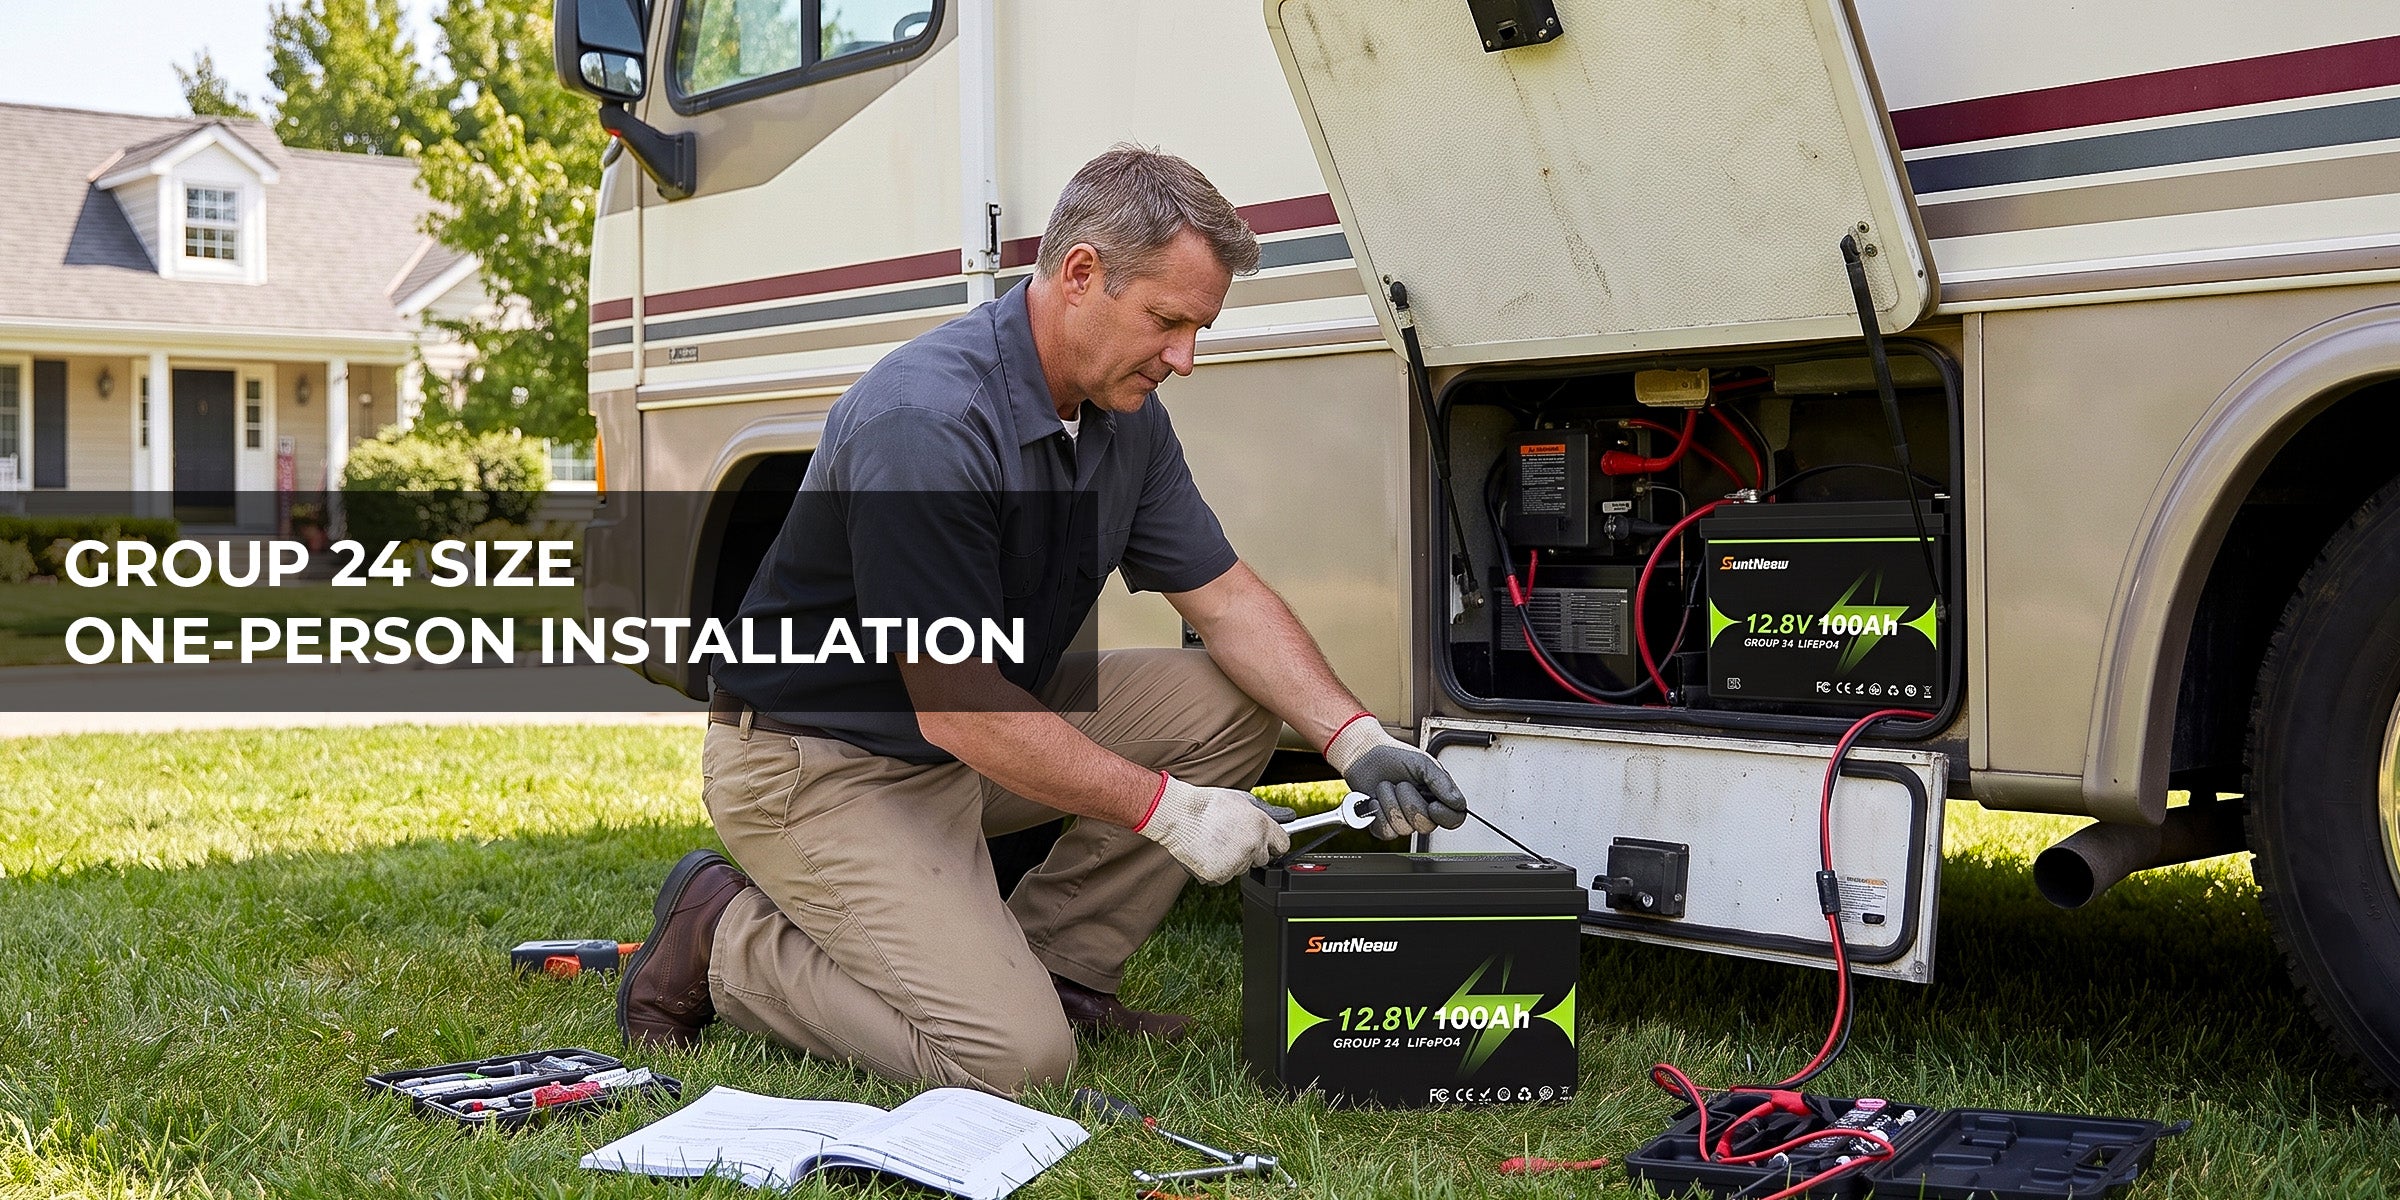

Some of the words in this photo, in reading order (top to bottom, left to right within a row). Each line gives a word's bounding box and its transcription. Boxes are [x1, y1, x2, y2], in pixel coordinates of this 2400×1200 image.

[1746, 613, 1813, 635] 12.8V
[1819, 614, 1898, 636] 100Ah
[1744, 638, 1779, 649] GROUP
[1338, 1006, 1428, 1031] 12.8V
[1433, 1003, 1530, 1030] 100Ah
[1333, 1038, 1381, 1049] GROUP
[1384, 1037, 1400, 1048] 24
[1455, 1087, 1473, 1102] CE
